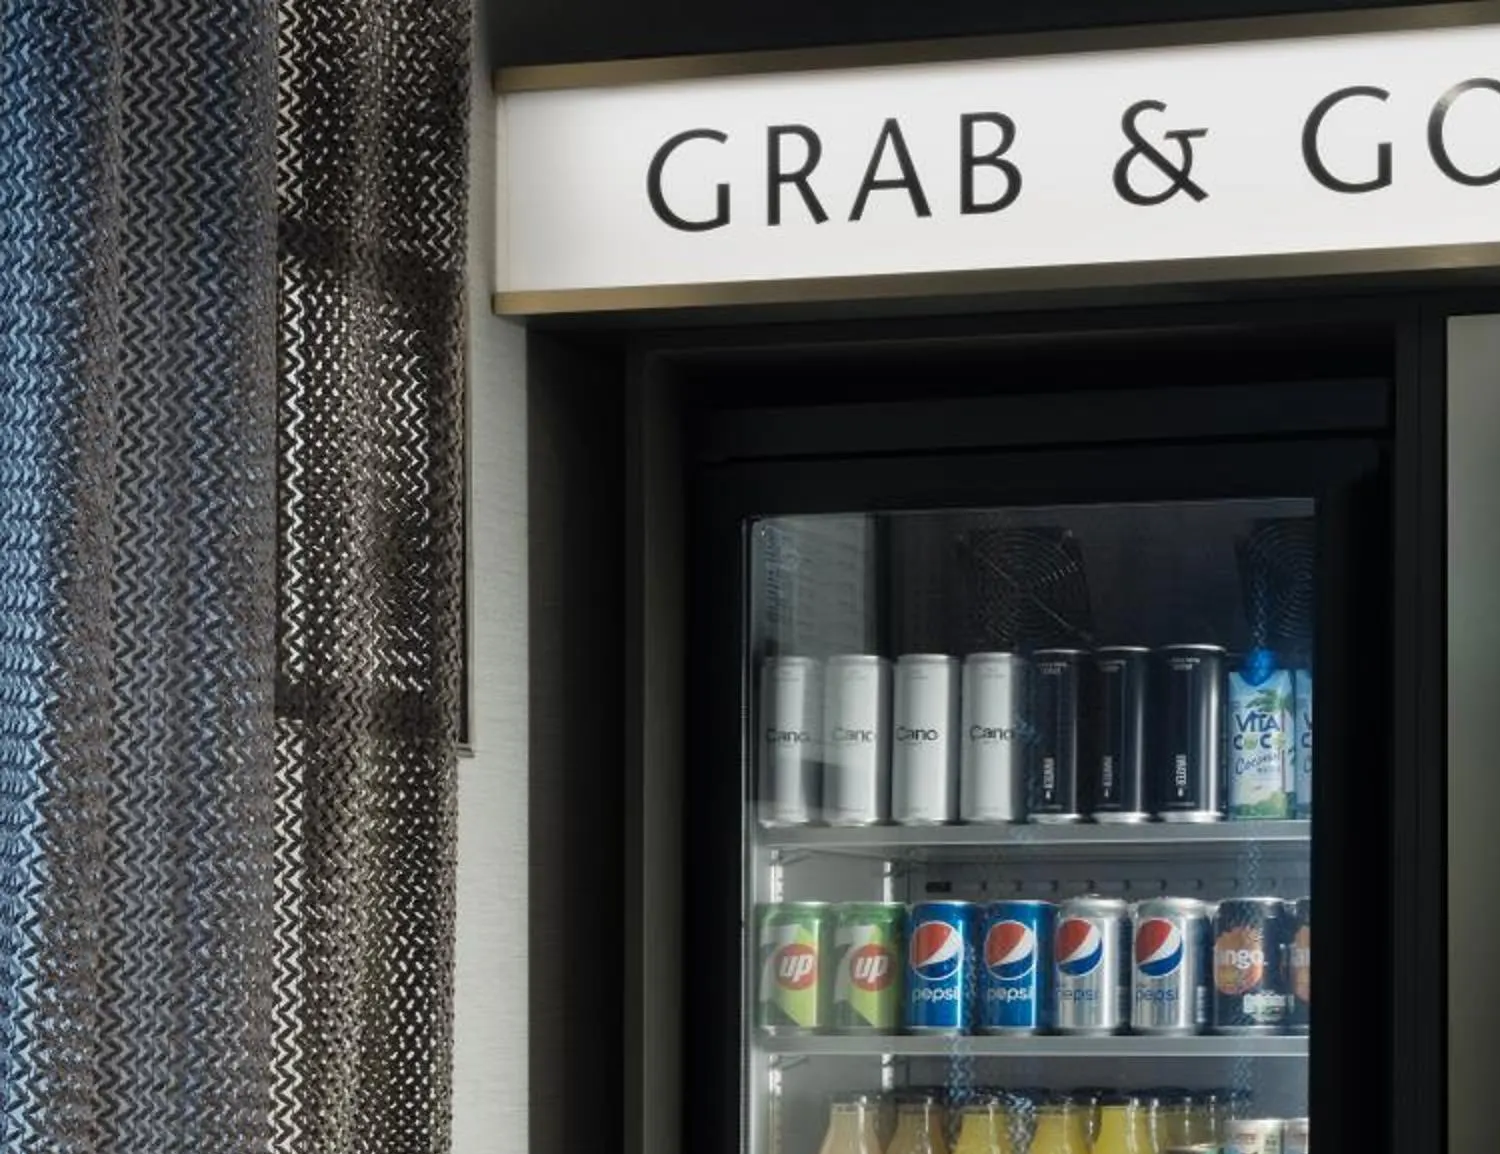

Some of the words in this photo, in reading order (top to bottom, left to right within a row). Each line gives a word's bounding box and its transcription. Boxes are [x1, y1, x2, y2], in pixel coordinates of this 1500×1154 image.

[645, 111, 1023, 232] GRAB
[1112, 99, 1209, 205] &
[1236, 713, 1279, 732] VITA
[912, 986, 960, 1002] pepsi
[987, 986, 1035, 1002] pepsi
